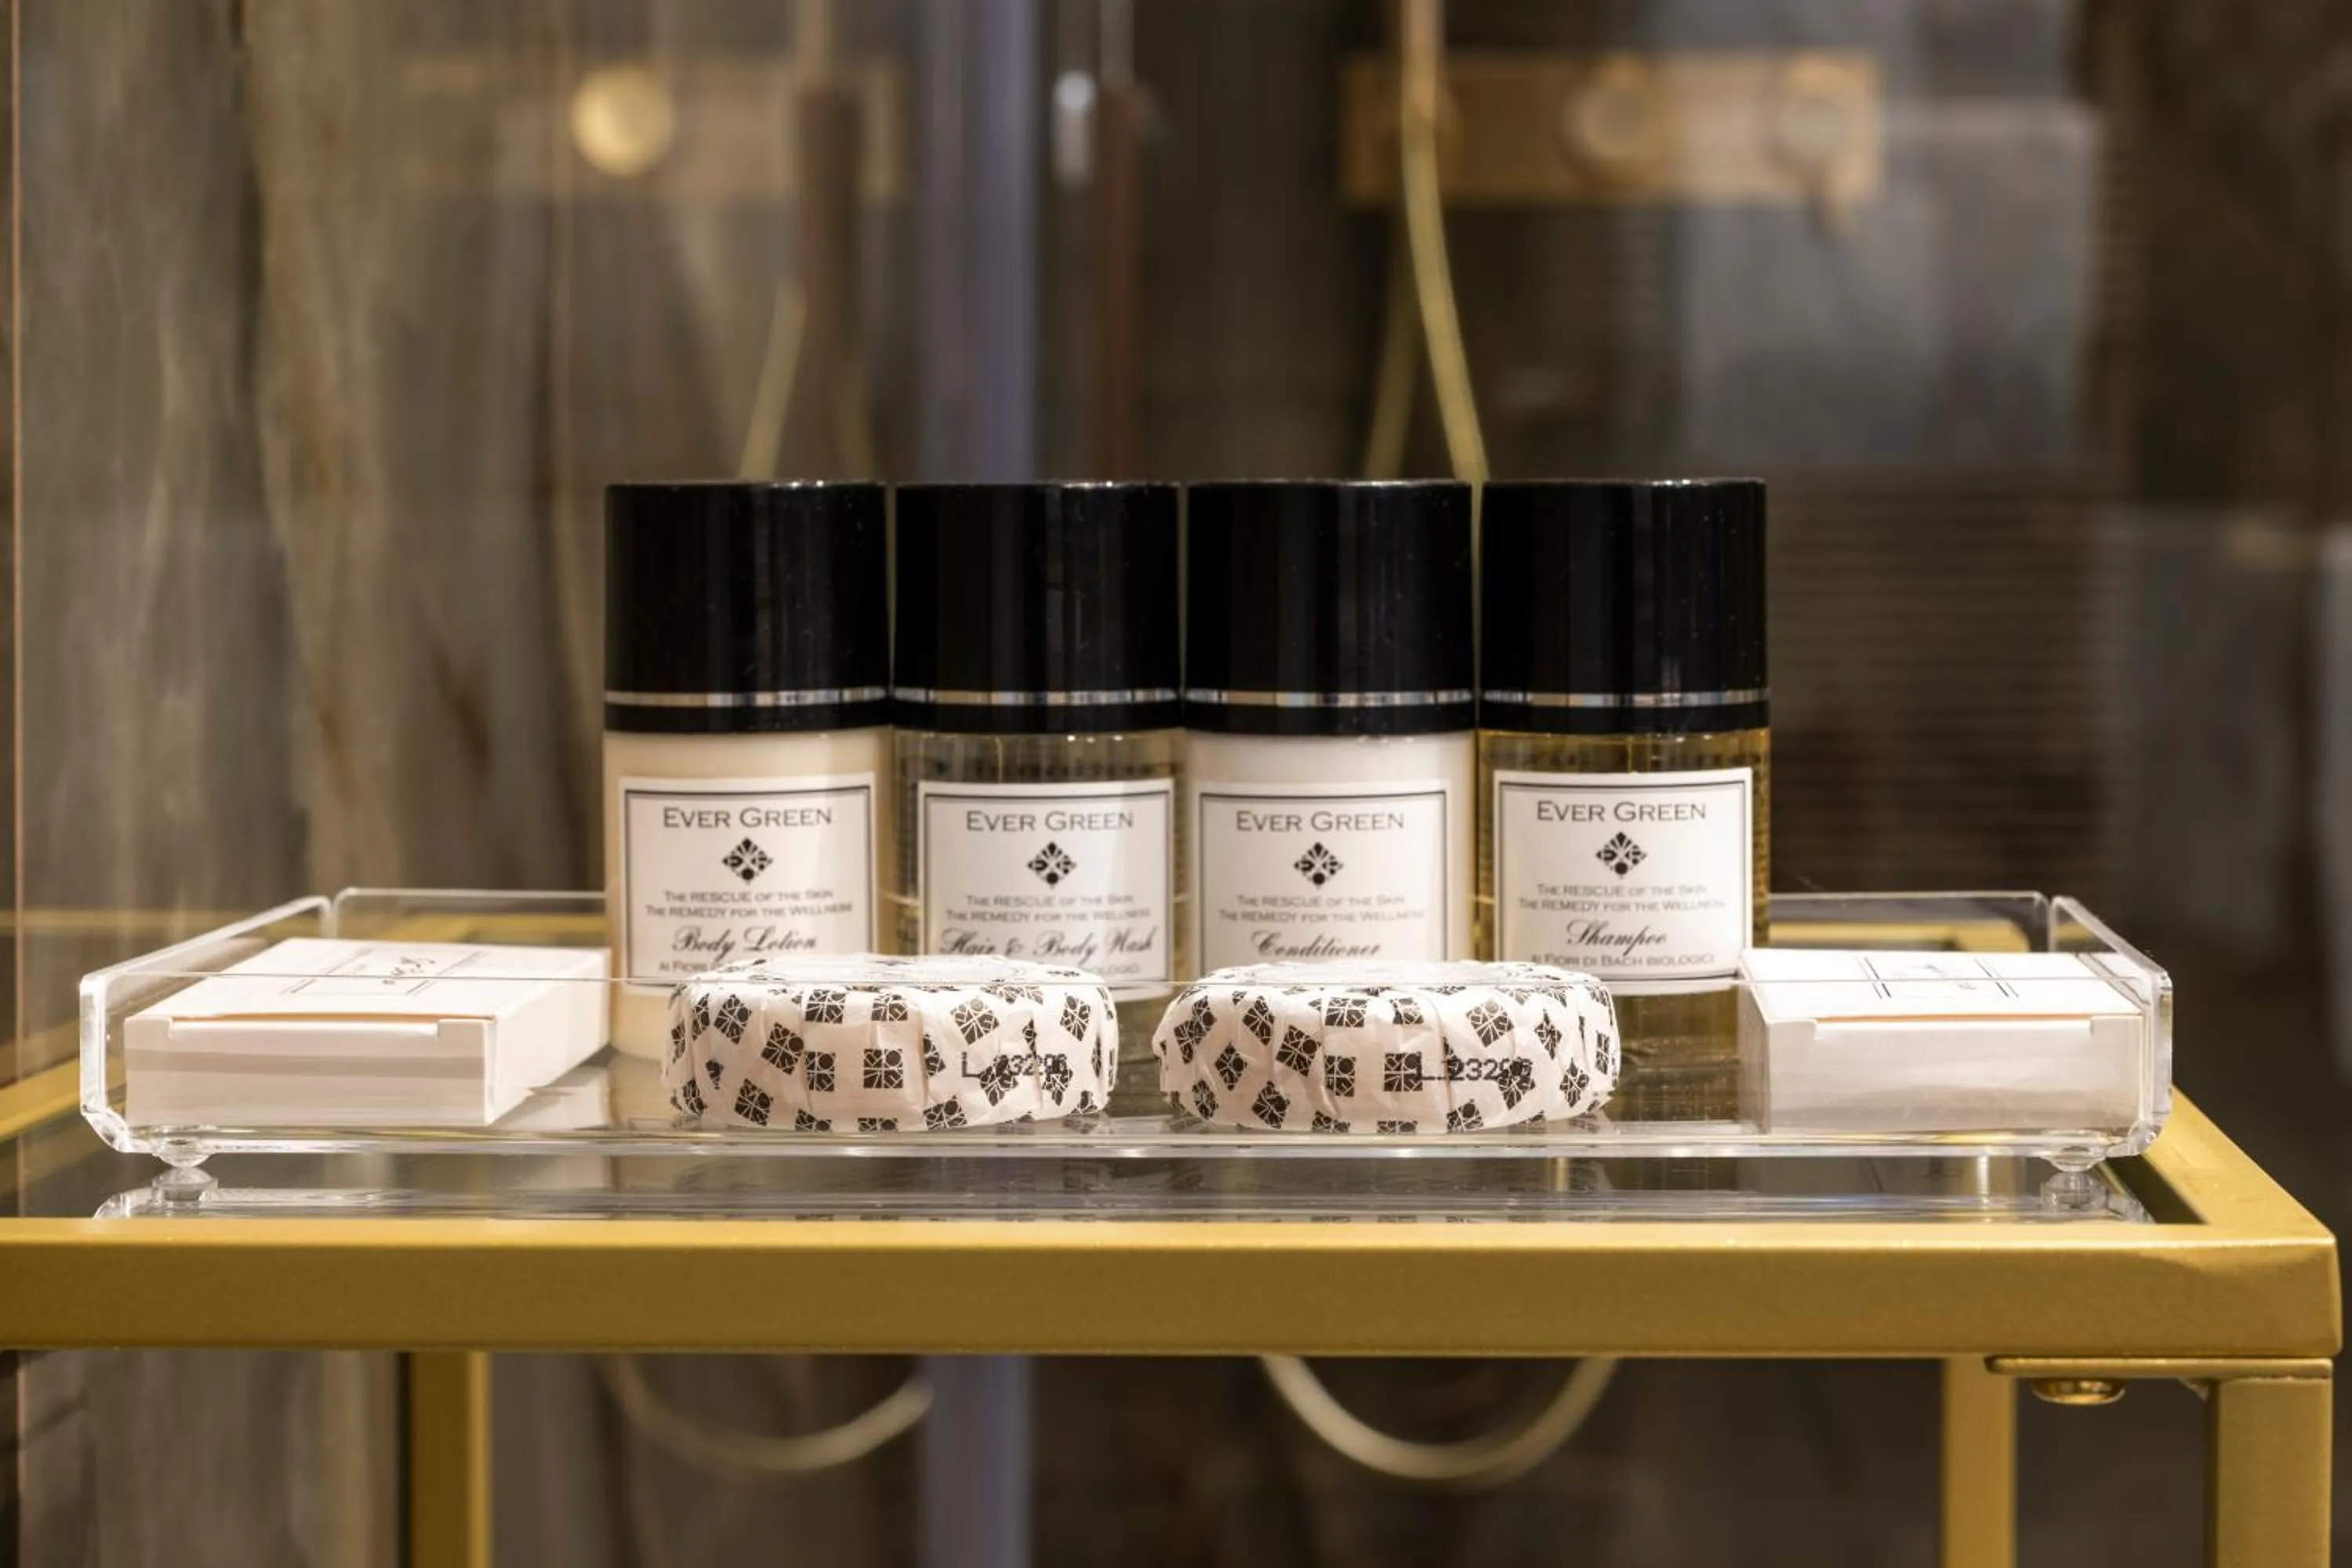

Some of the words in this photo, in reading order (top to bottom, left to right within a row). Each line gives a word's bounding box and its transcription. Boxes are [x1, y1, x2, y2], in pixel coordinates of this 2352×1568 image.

[663, 807, 731, 828] EVER
[739, 808, 833, 828] GREEN
[966, 810, 1036, 832] EVER
[1044, 810, 1134, 832] GREEN
[1236, 809, 1303, 832] EVER
[1311, 811, 1405, 832] GREEN
[1537, 800, 1605, 822] EVER
[1613, 800, 1707, 822] GREEN
[672, 925, 736, 962] Body
[742, 926, 817, 953] Lotion
[938, 927, 997, 956] Hair
[1032, 929, 1097, 965] Body
[1104, 924, 1160, 954] Wash
[1250, 929, 1381, 957] Conditioner
[1566, 918, 1668, 956] Shampoo
